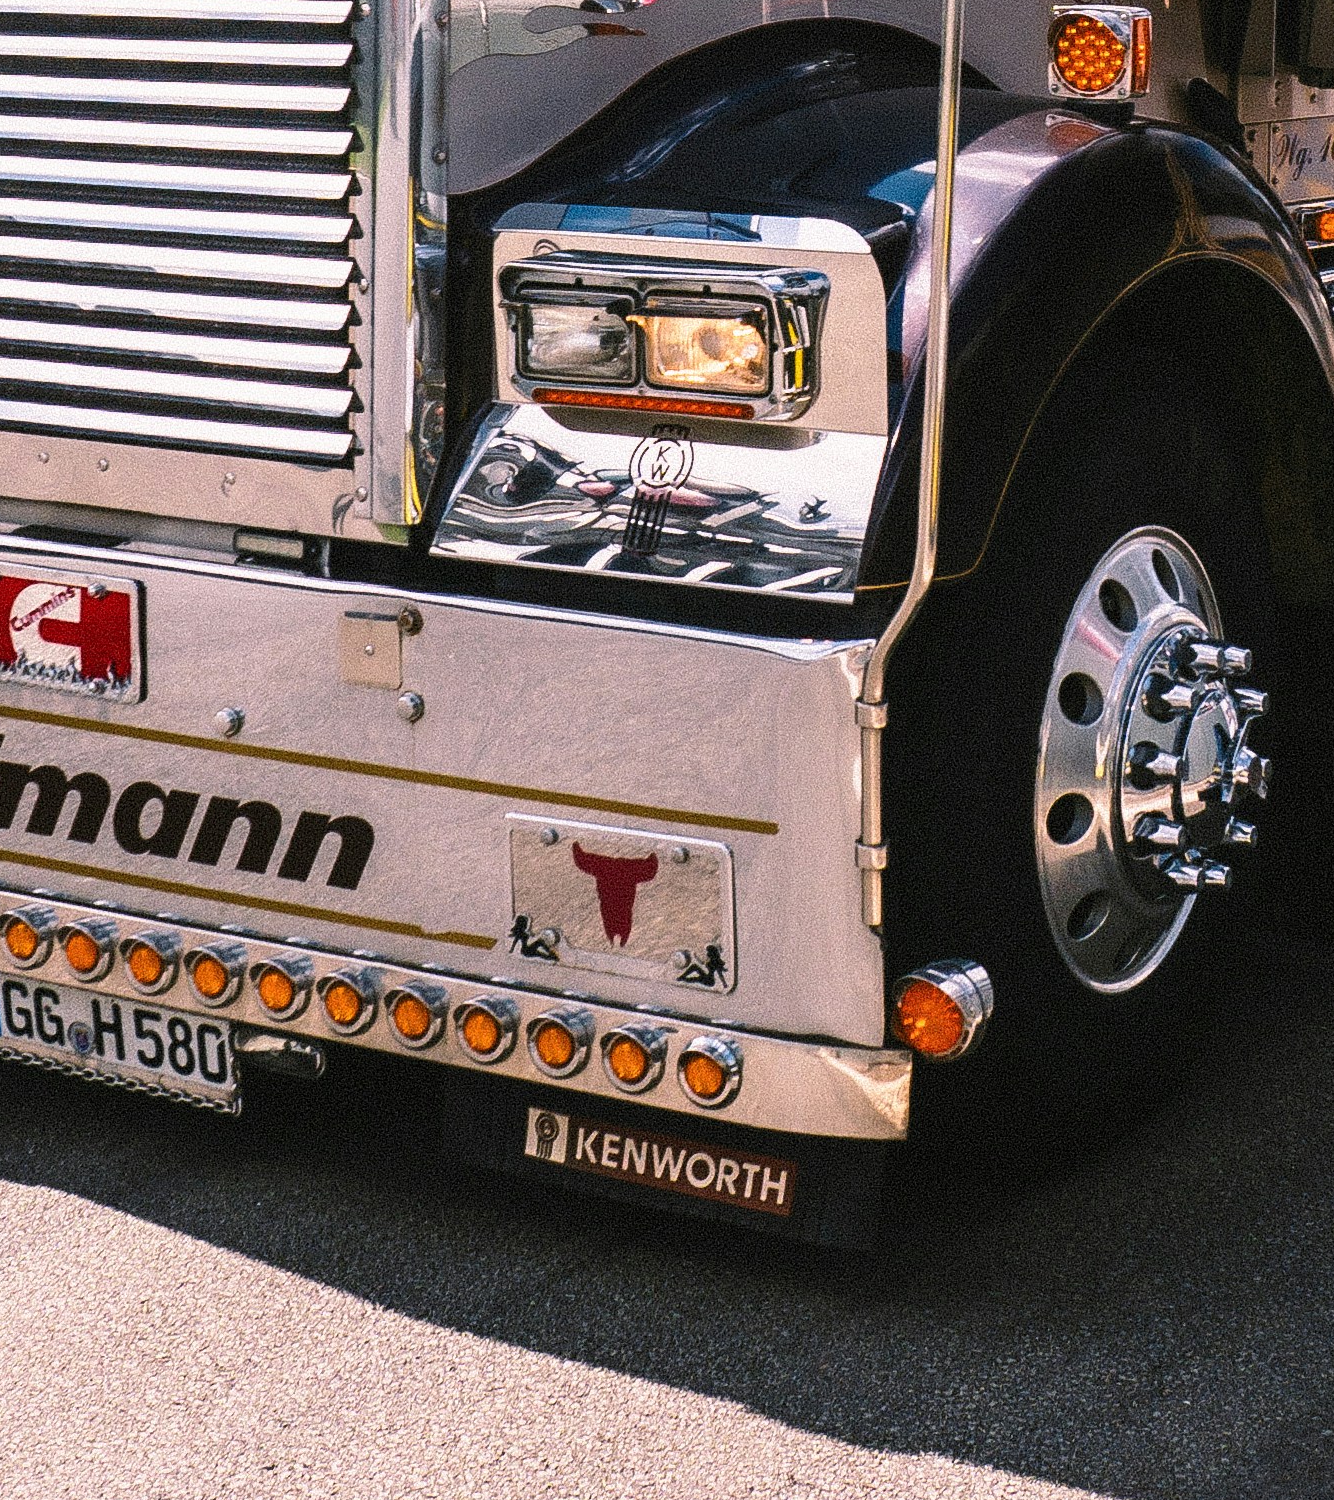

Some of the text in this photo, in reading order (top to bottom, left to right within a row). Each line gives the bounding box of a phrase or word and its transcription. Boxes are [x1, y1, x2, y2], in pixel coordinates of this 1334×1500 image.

[10, 586, 77, 633] Cummins
[1, 979, 66, 1046] GG
[132, 1008, 228, 1085] 580
[575, 1127, 788, 1205] KENWORTH
